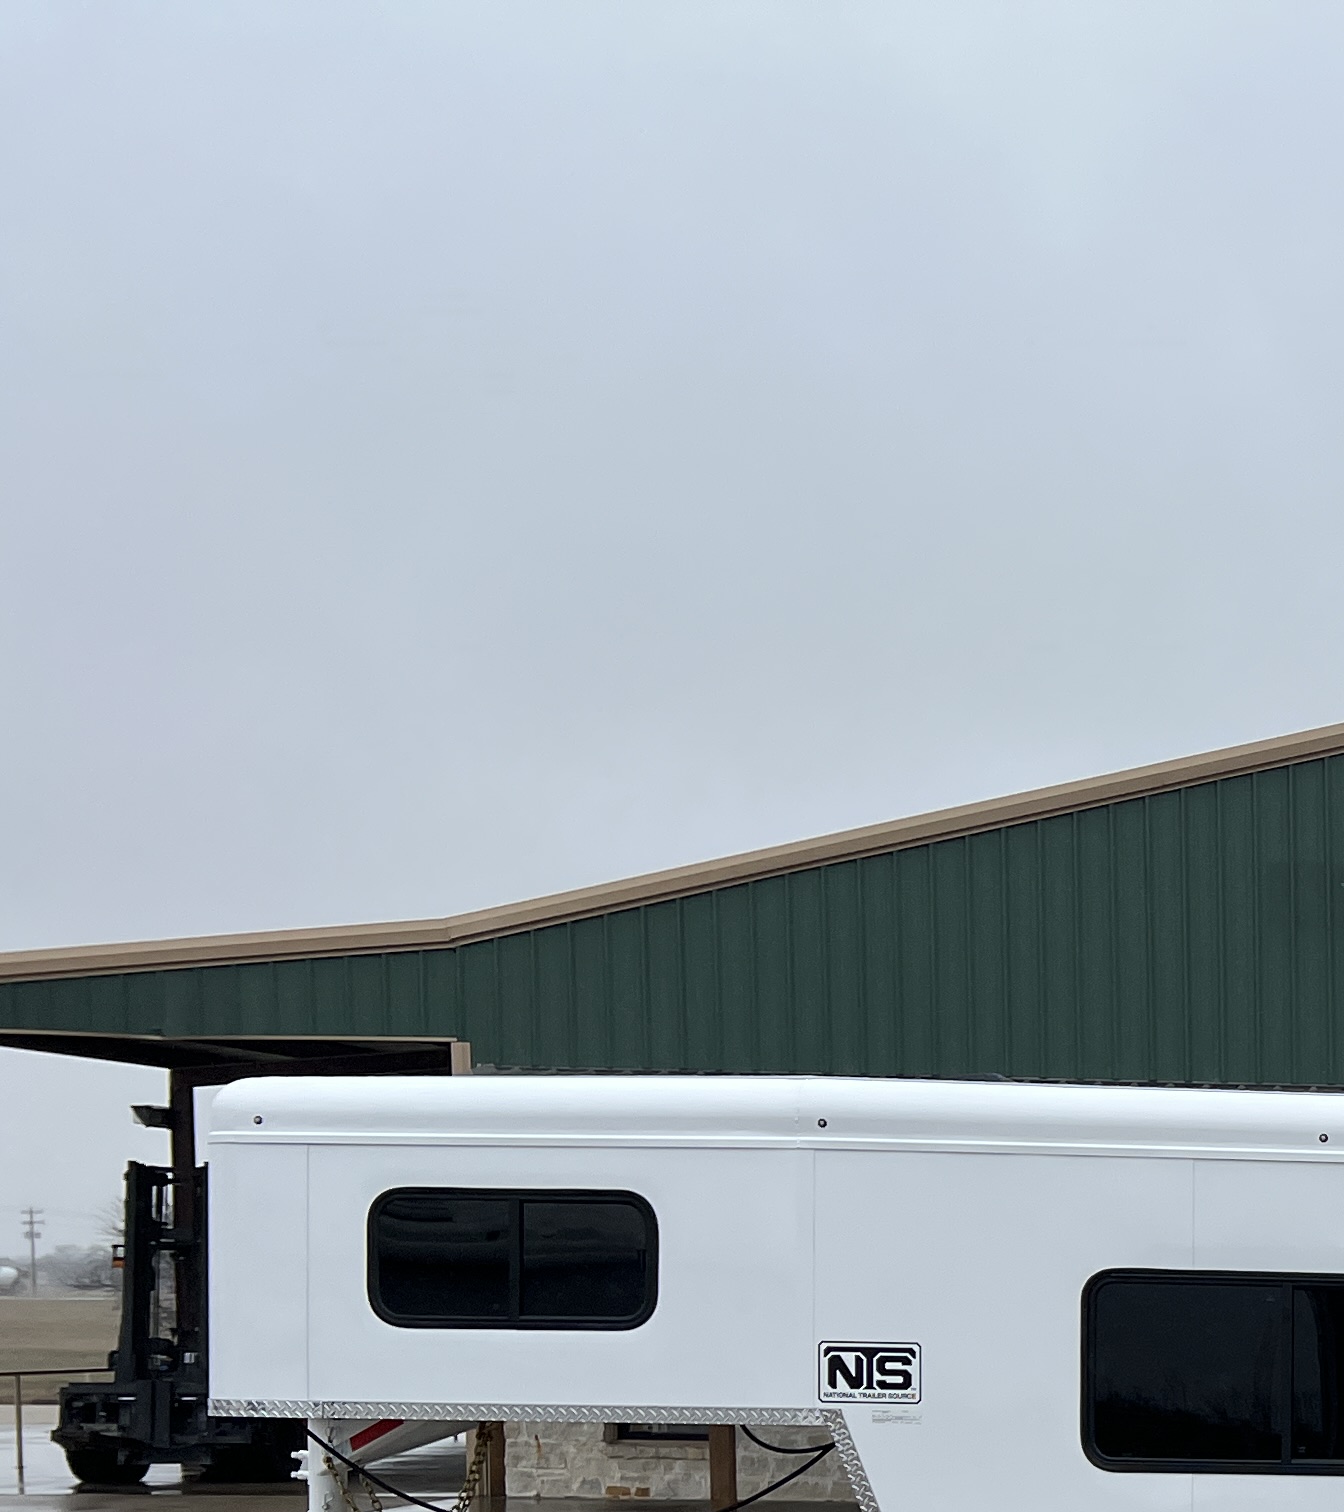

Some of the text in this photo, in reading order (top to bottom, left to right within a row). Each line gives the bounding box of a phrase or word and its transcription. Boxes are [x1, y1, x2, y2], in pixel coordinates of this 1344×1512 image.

[823, 1346, 916, 1390] NTS
[823, 1391, 917, 1400] NATIONAL TRAILER SOURCE
